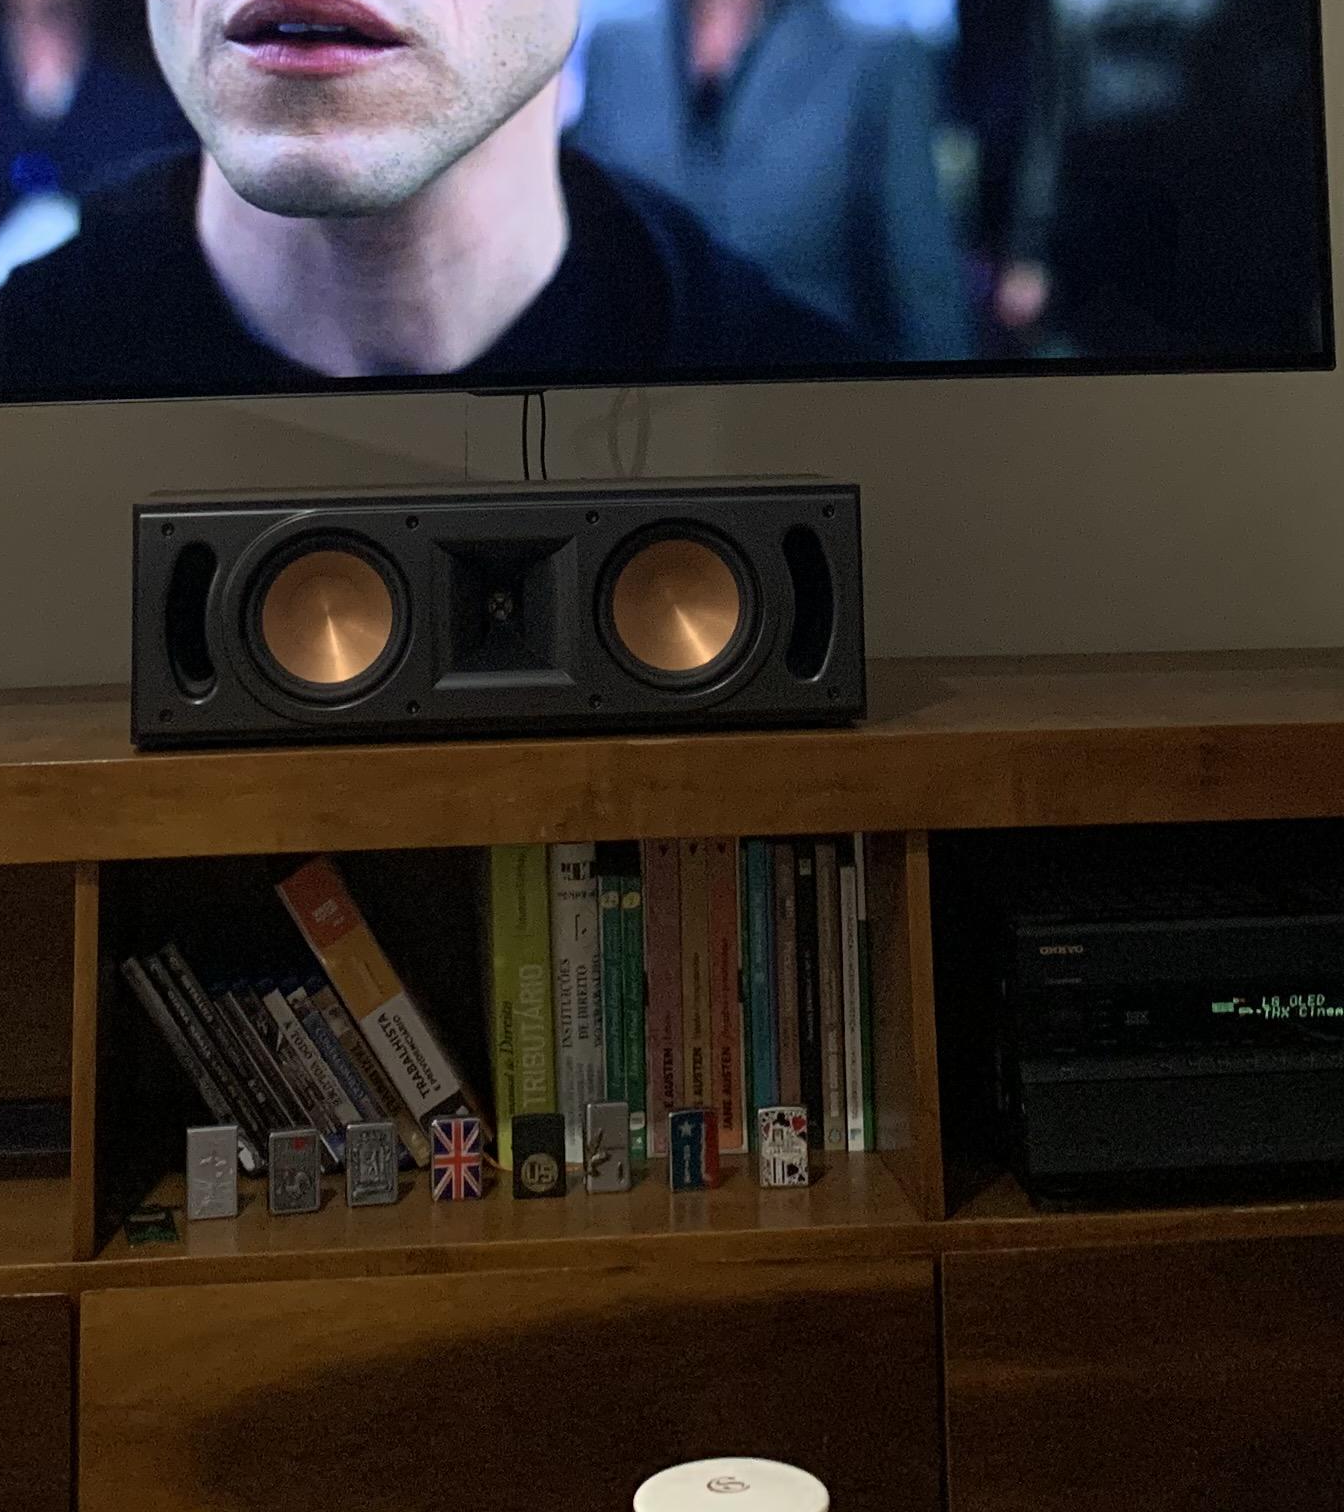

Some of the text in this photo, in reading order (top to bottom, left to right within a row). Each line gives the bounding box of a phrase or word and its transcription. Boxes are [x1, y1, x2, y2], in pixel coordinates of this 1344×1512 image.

[575, 963, 590, 1019] DIREITO
[1289, 994, 1326, 1006] OLED
[288, 1029, 312, 1061] TODO
[376, 1011, 431, 1099] TRABALHISTA
[512, 963, 548, 1108] TRIBUTÁRIO
[661, 1046, 674, 1098] AUSTEN
[691, 1046, 704, 1096] AUSTEN
[720, 1046, 732, 1098] AUSTEN
